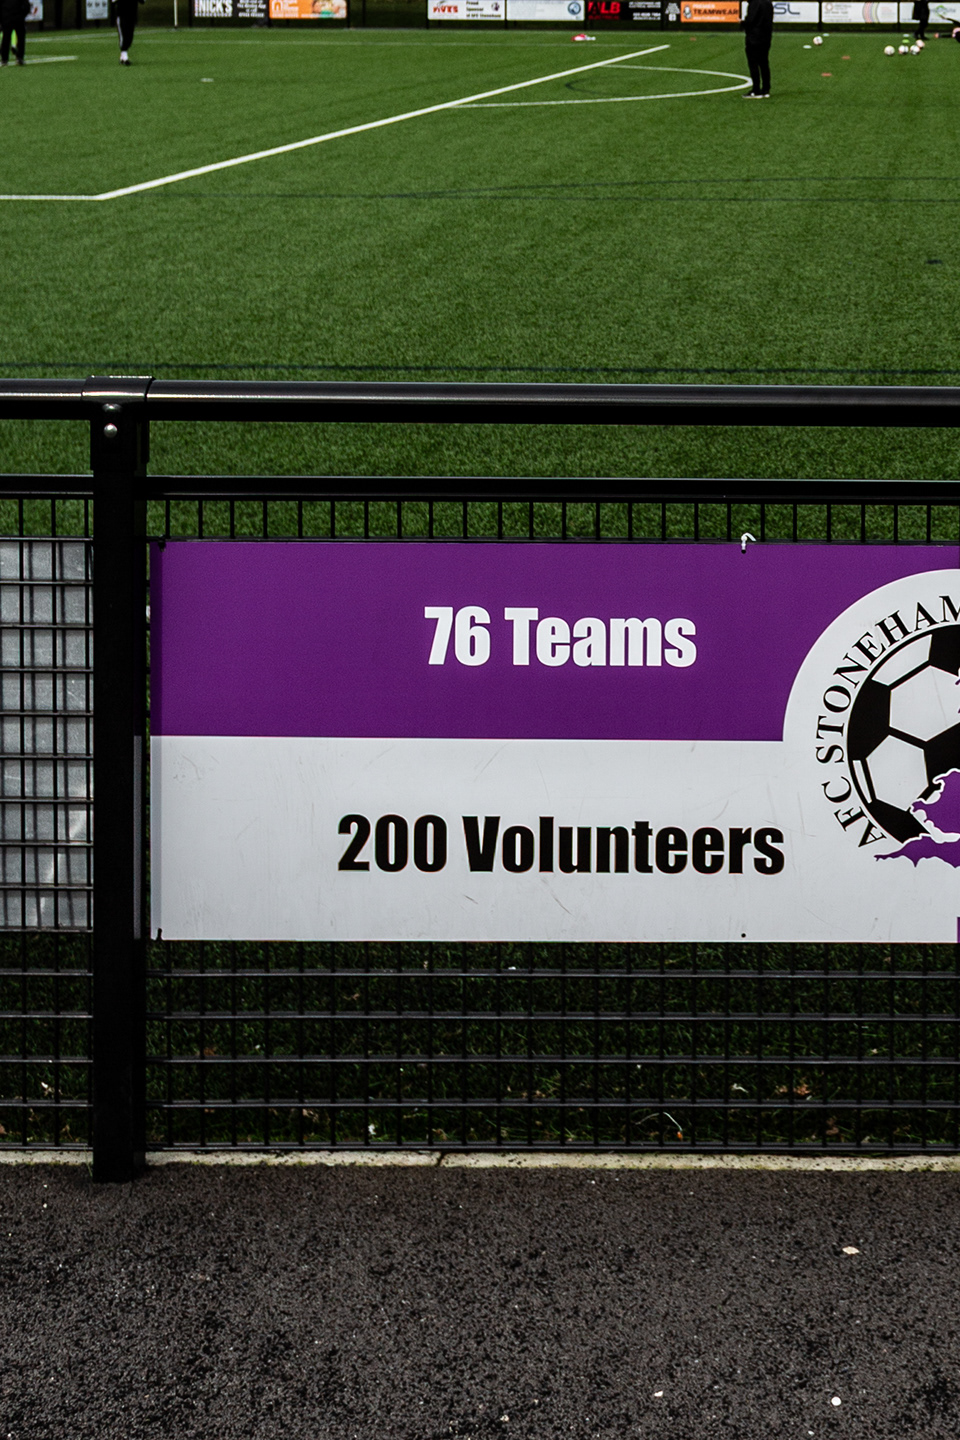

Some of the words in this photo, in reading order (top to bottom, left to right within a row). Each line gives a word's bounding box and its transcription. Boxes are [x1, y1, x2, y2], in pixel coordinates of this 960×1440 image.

[425, 606, 490, 666] 76
[505, 608, 696, 667] Teams
[821, 776, 887, 848] AFC
[338, 815, 446, 872] 200
[463, 816, 784, 874] Volunteers
